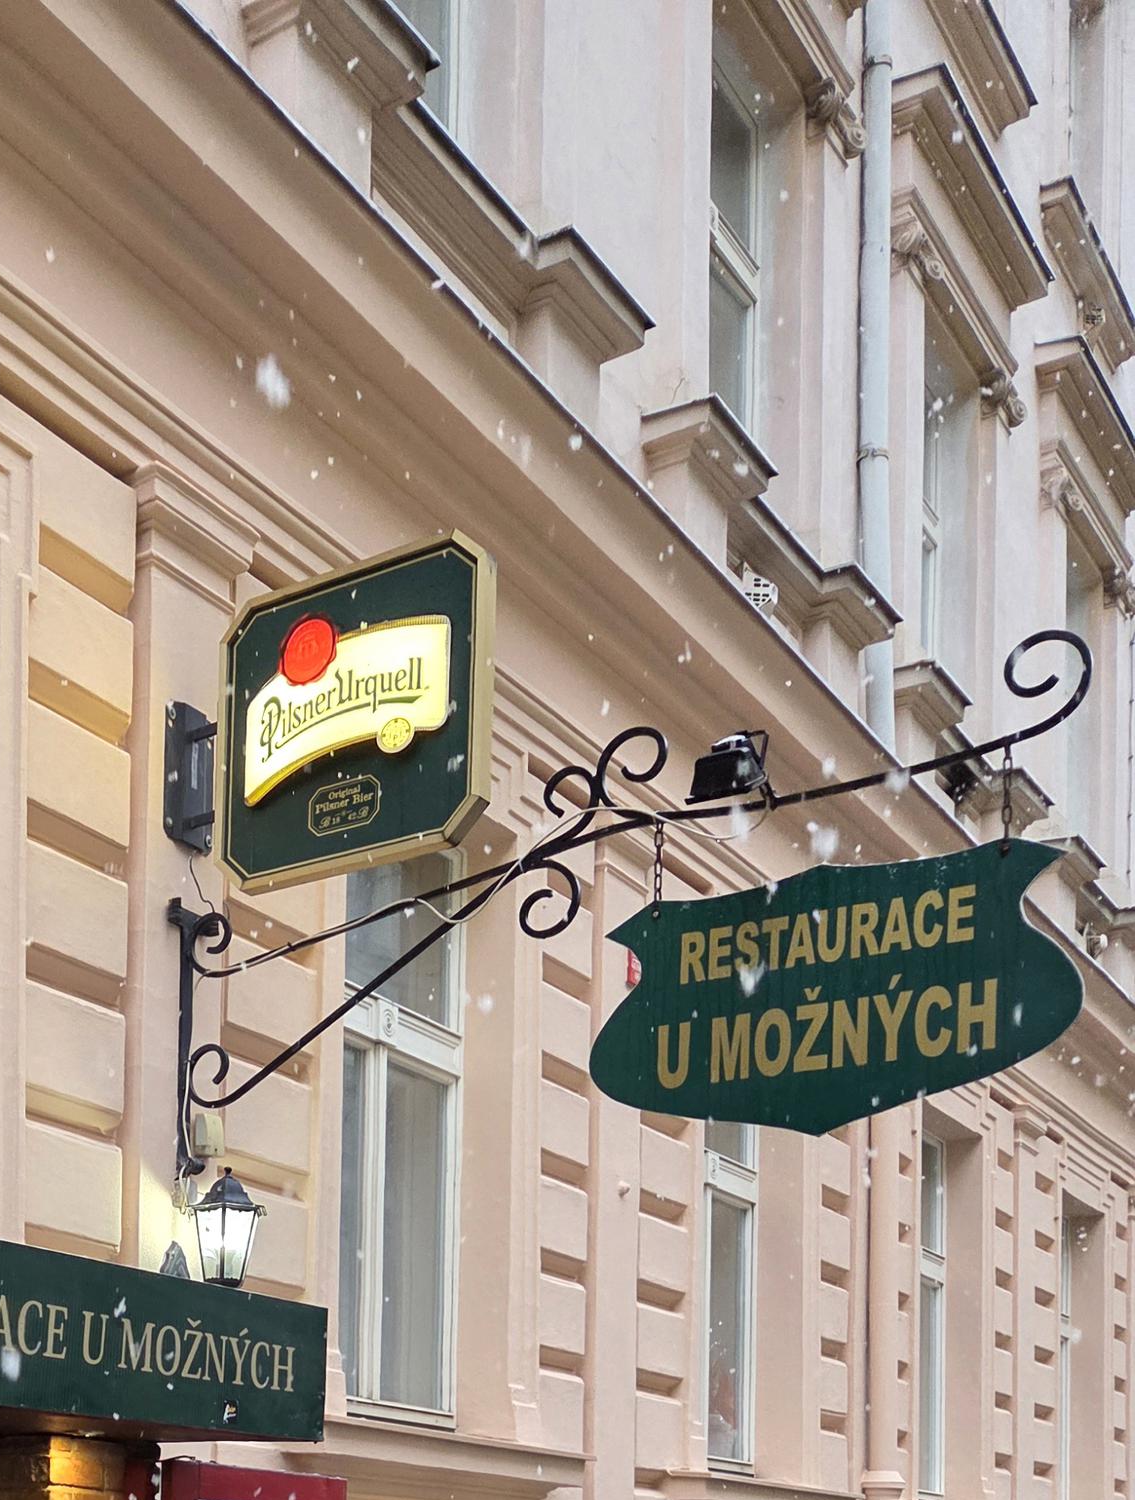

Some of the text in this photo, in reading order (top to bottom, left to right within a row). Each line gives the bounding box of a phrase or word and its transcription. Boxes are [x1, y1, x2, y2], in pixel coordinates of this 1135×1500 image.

[260, 657, 423, 763] Pilsner Urquell
[315, 792, 374, 814] Pilsner Bier
[328, 785, 361, 800] Original
[679, 884, 977, 985] RESTAURACE
[656, 974, 998, 1090] U MOŽNÝCH
[82, 1311, 110, 1366] U
[117, 1317, 295, 1392] MOŽNÝCH
